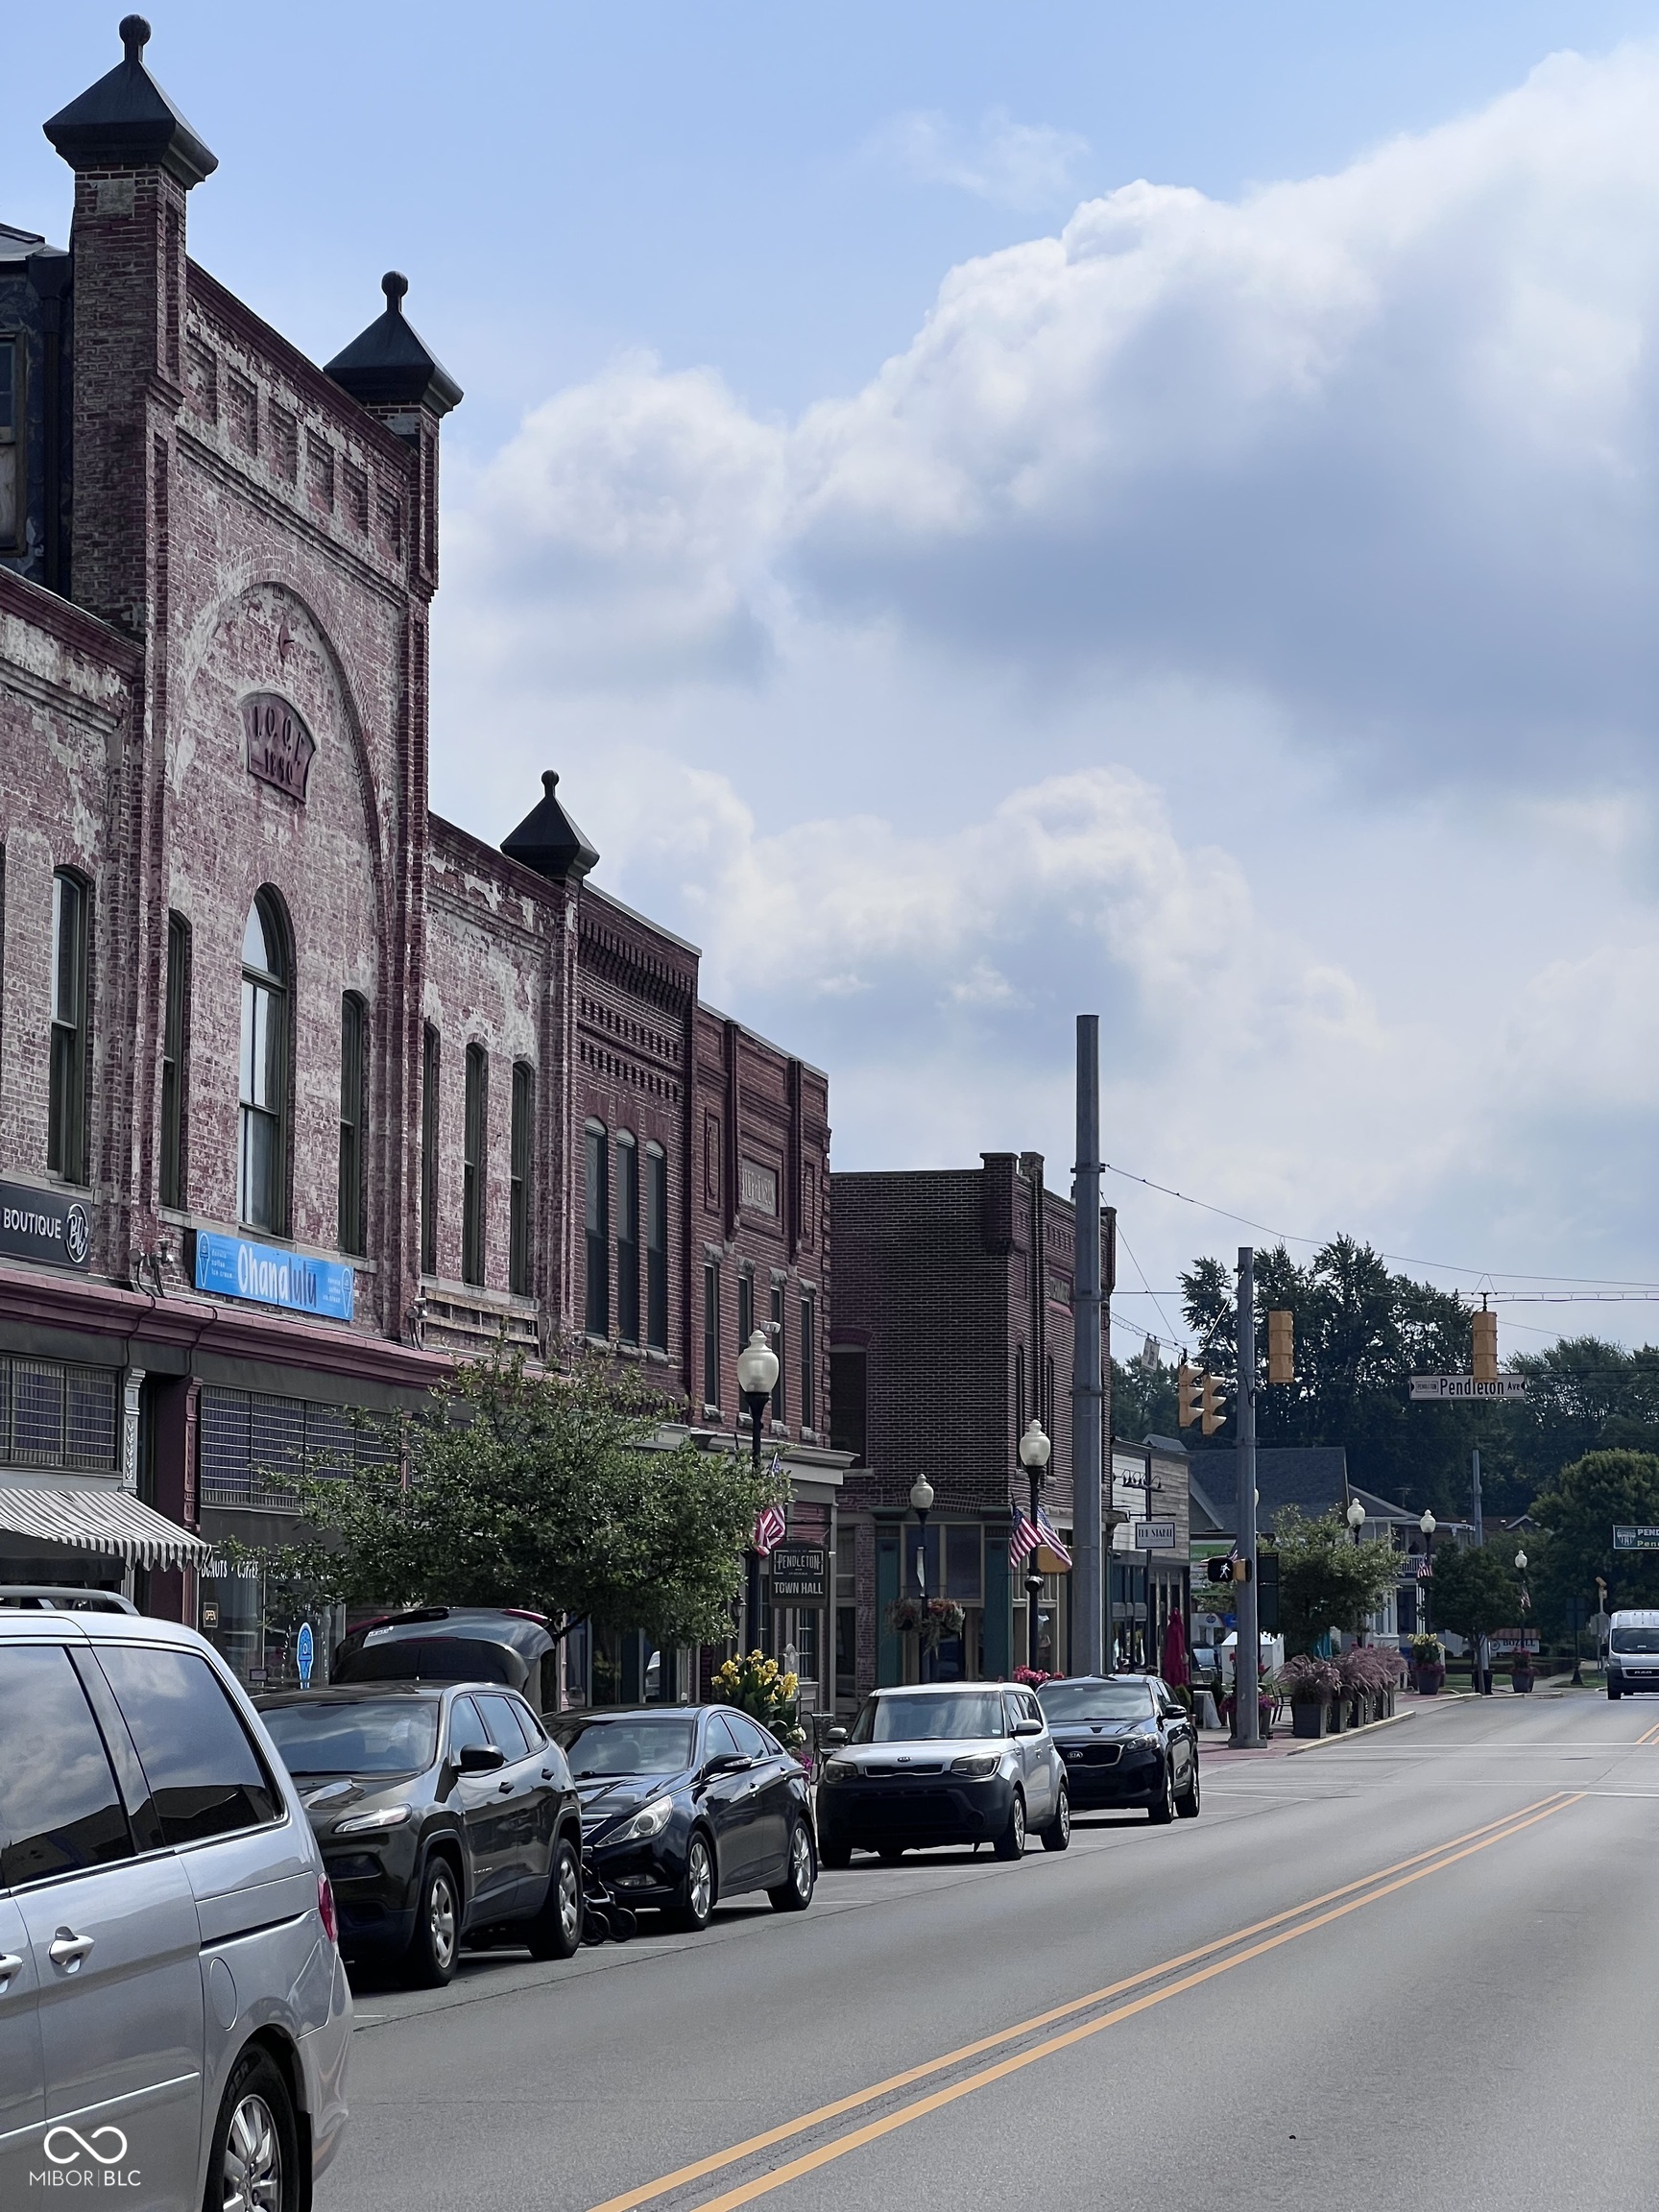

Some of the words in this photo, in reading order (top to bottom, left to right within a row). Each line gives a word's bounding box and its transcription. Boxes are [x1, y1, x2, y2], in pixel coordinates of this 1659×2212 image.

[3, 1207, 61, 1239] BOUTIQUE
[237, 1243, 317, 1309] Ohanalulu
[1440, 1378, 1504, 1395] Pendleton
[1507, 1382, 1521, 1390] Ave
[778, 1553, 820, 1570] PENDLETON
[774, 1581, 799, 1594] TOWN
[801, 1582, 824, 1594] HALL
